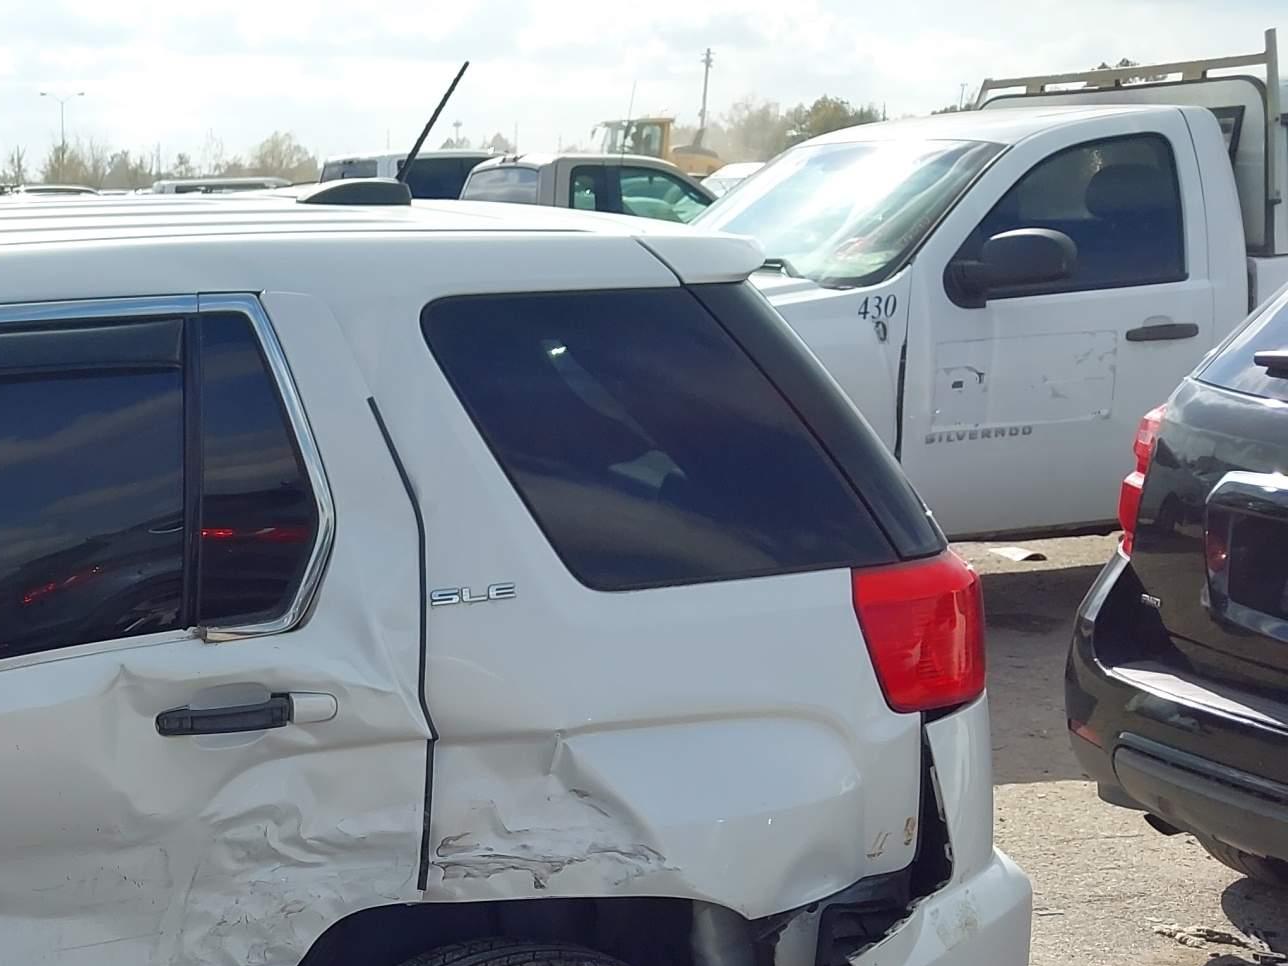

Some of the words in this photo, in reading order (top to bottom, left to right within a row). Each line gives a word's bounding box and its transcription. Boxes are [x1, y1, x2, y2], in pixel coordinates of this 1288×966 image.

[858, 294, 897, 320] 430
[925, 425, 1033, 445] SILVERADO
[430, 582, 516, 606] SLE
